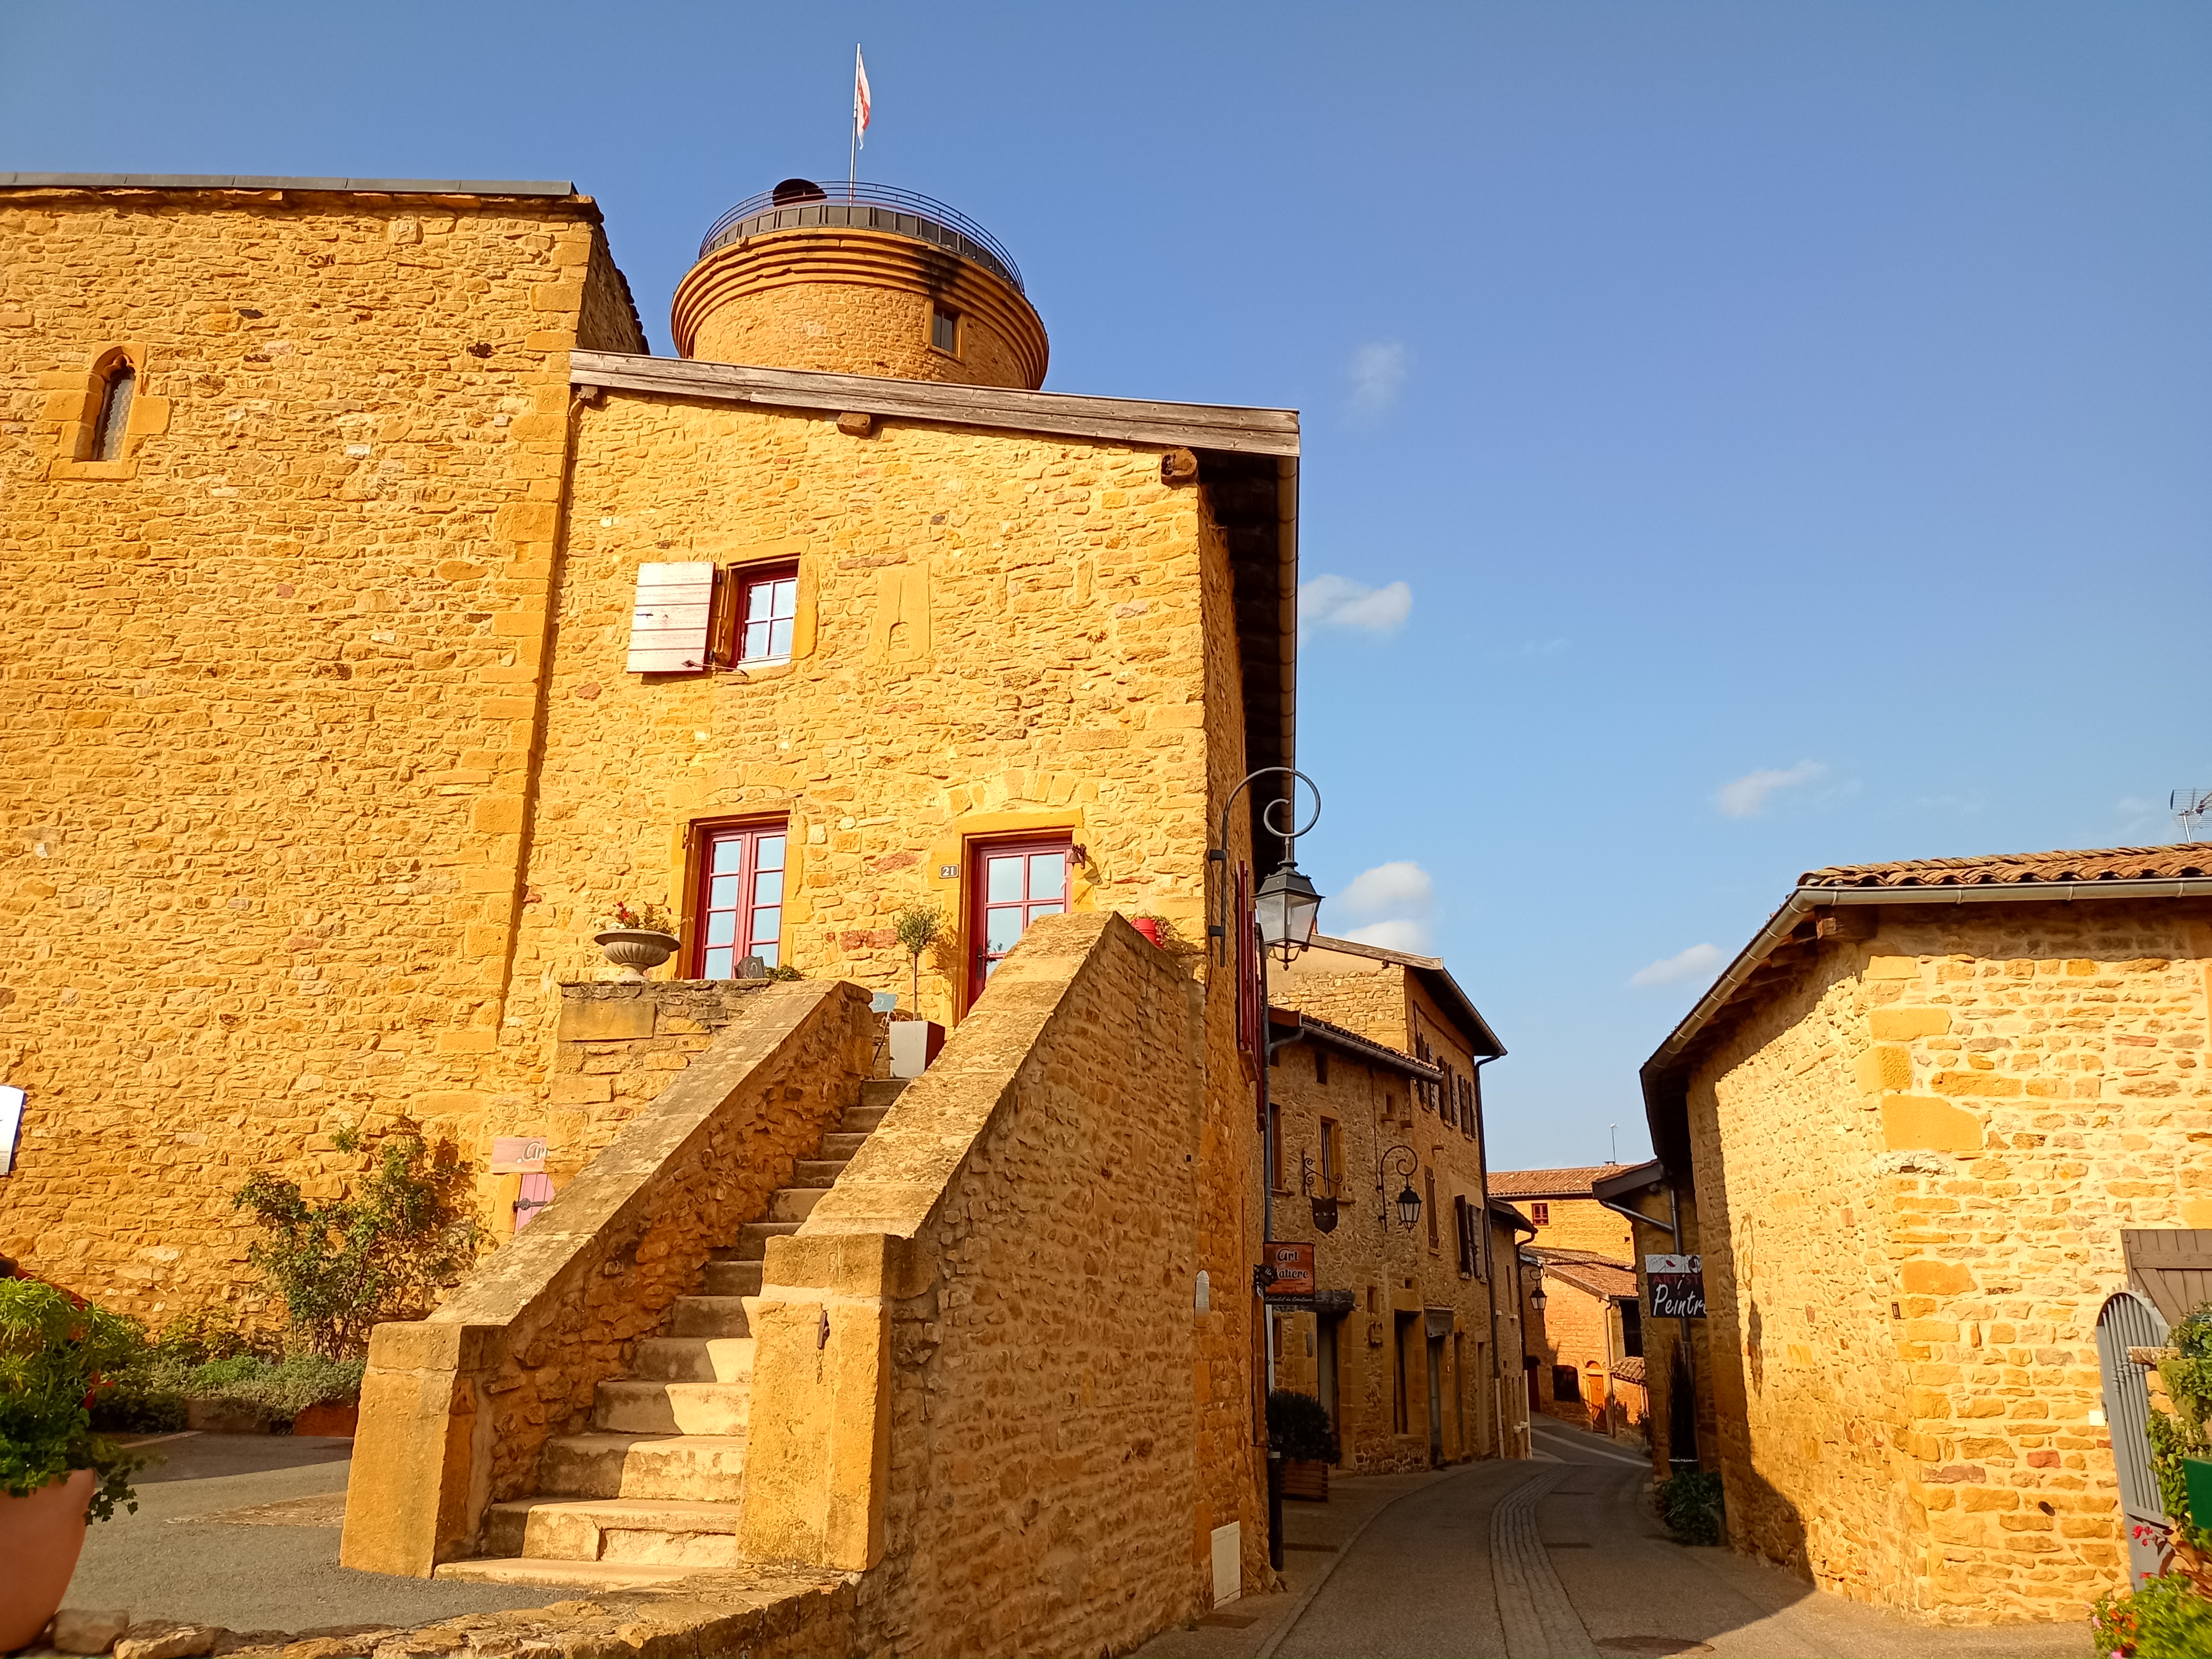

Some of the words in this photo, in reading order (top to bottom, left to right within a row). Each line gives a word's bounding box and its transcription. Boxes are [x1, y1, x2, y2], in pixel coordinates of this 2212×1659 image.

[942, 867, 954, 876] 21
[1277, 1248, 1298, 1261] Art
[1275, 1266, 1309, 1279] atière
